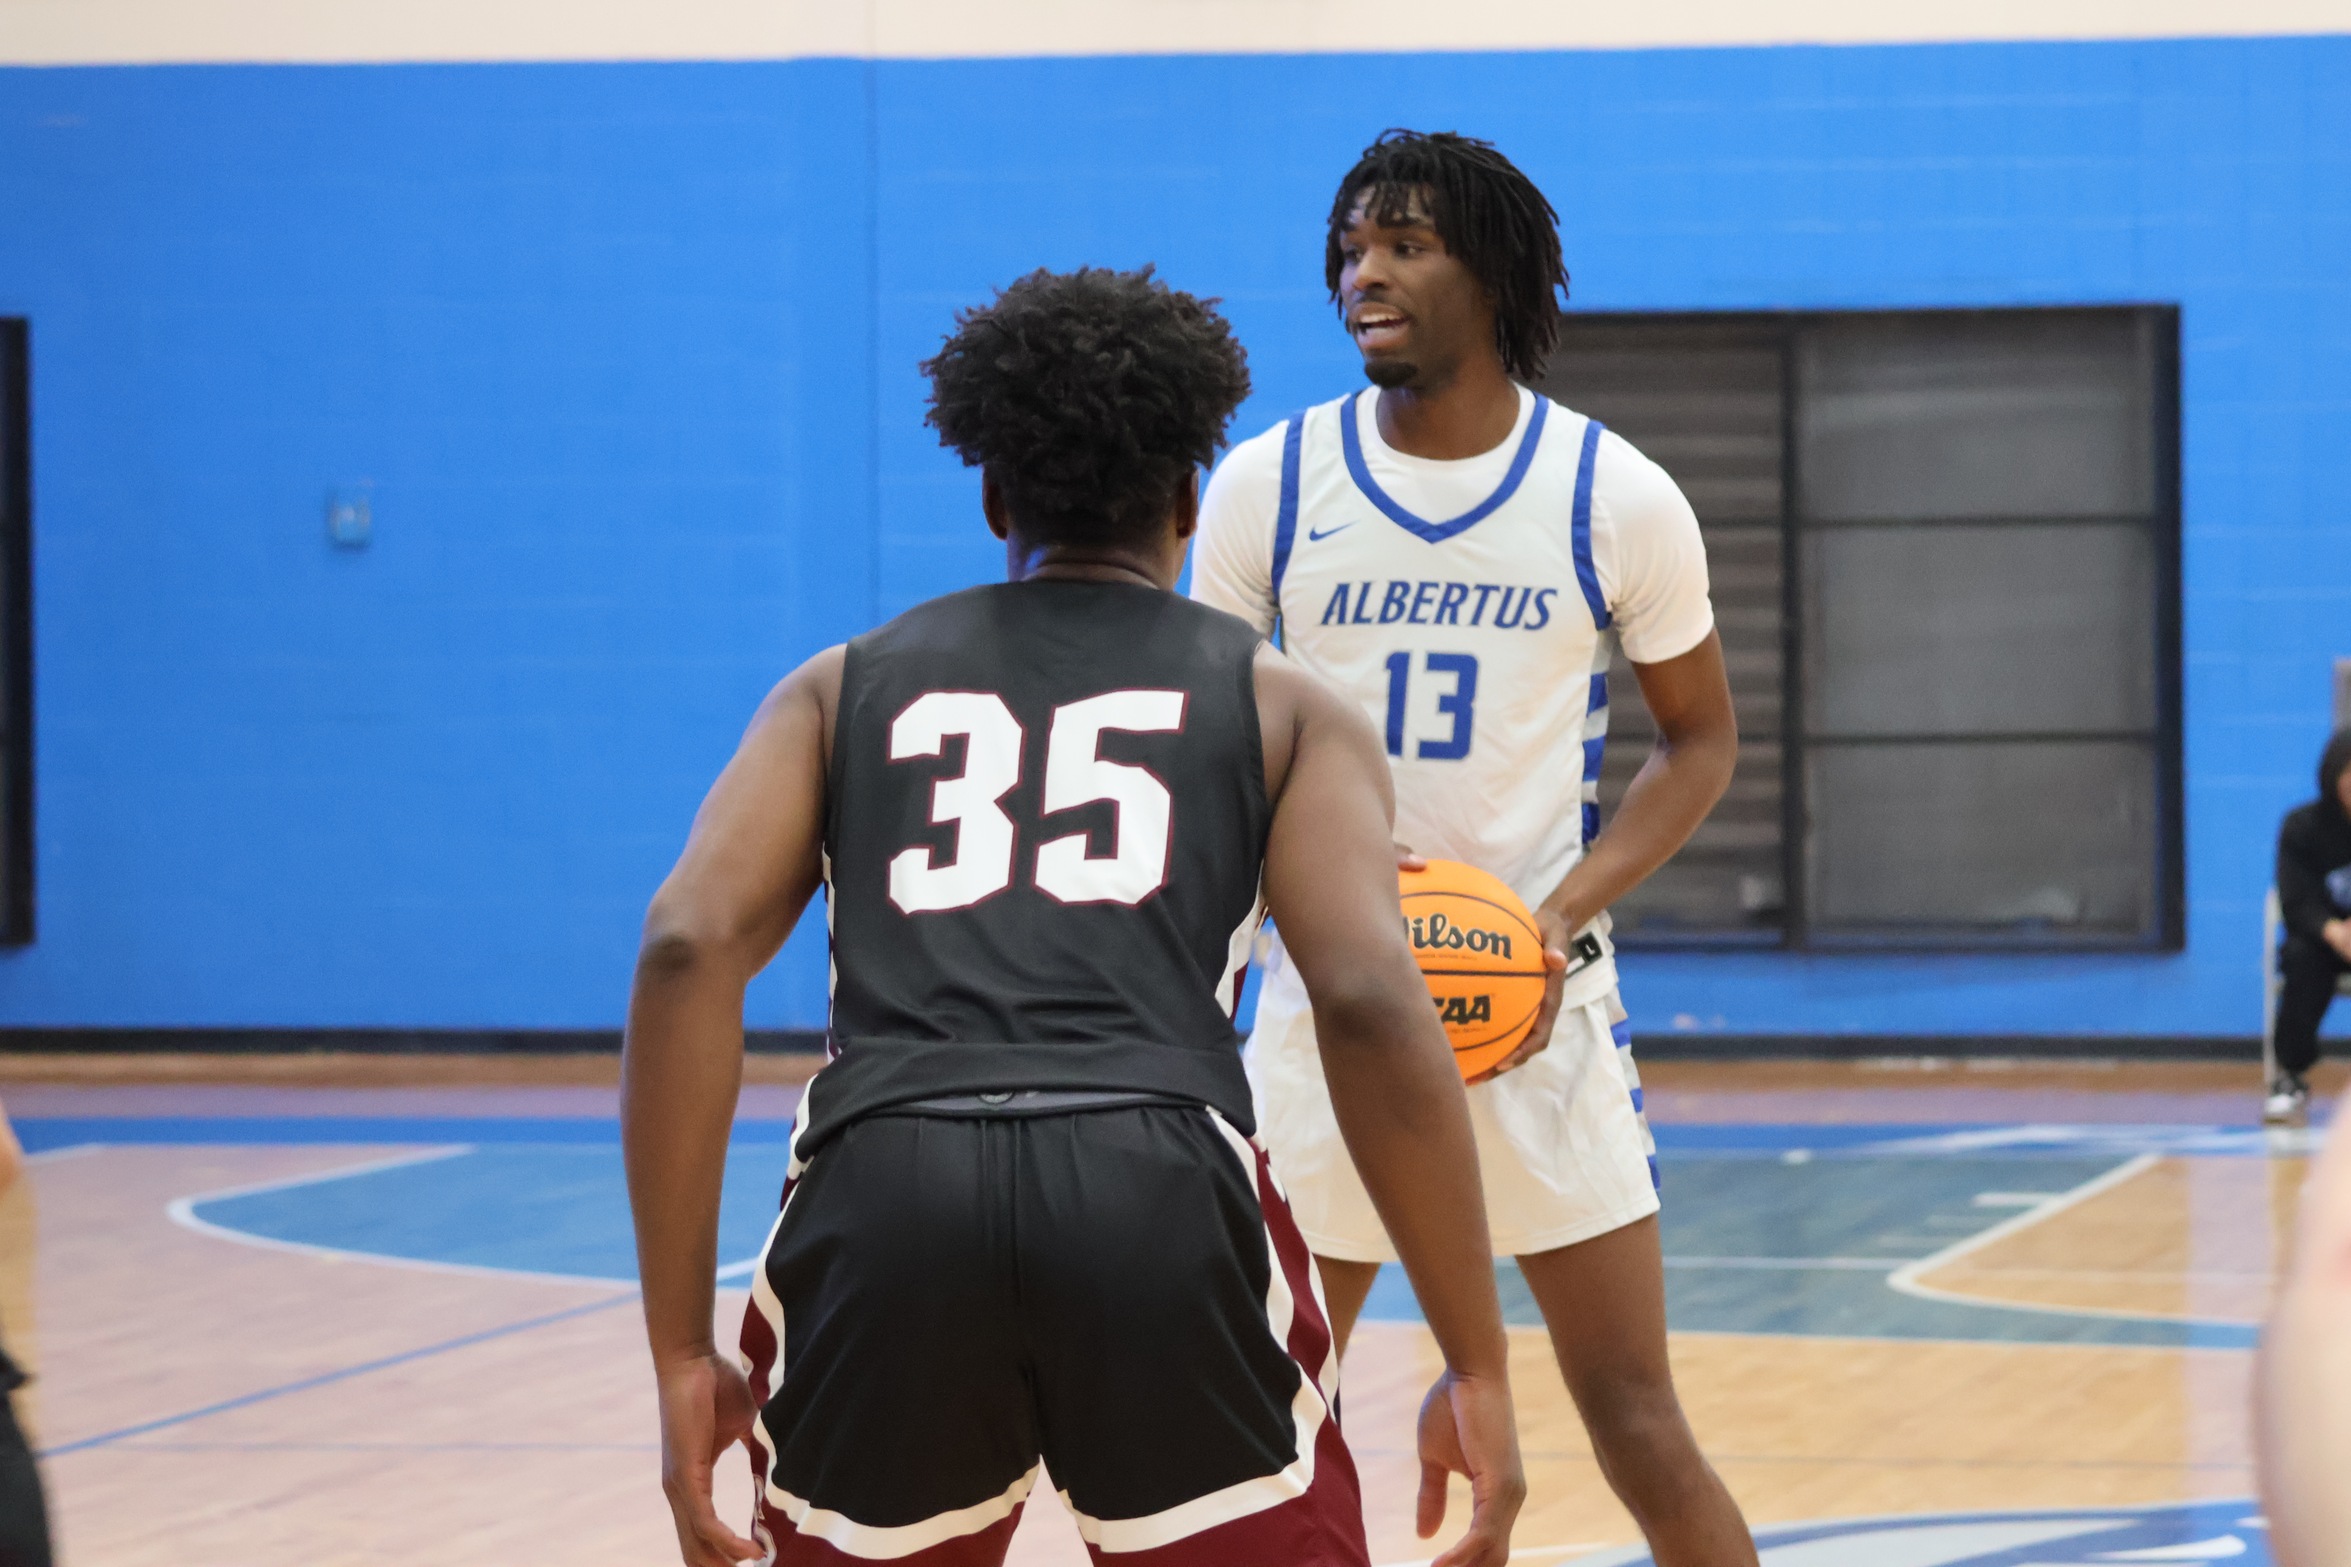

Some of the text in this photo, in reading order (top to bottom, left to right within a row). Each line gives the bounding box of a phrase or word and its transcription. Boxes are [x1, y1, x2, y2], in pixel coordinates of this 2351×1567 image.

[1319, 580, 1559, 631] ALBERTUS
[1385, 650, 1479, 760] 13
[886, 687, 1189, 917] 35
[1402, 913, 1513, 960] ilson
